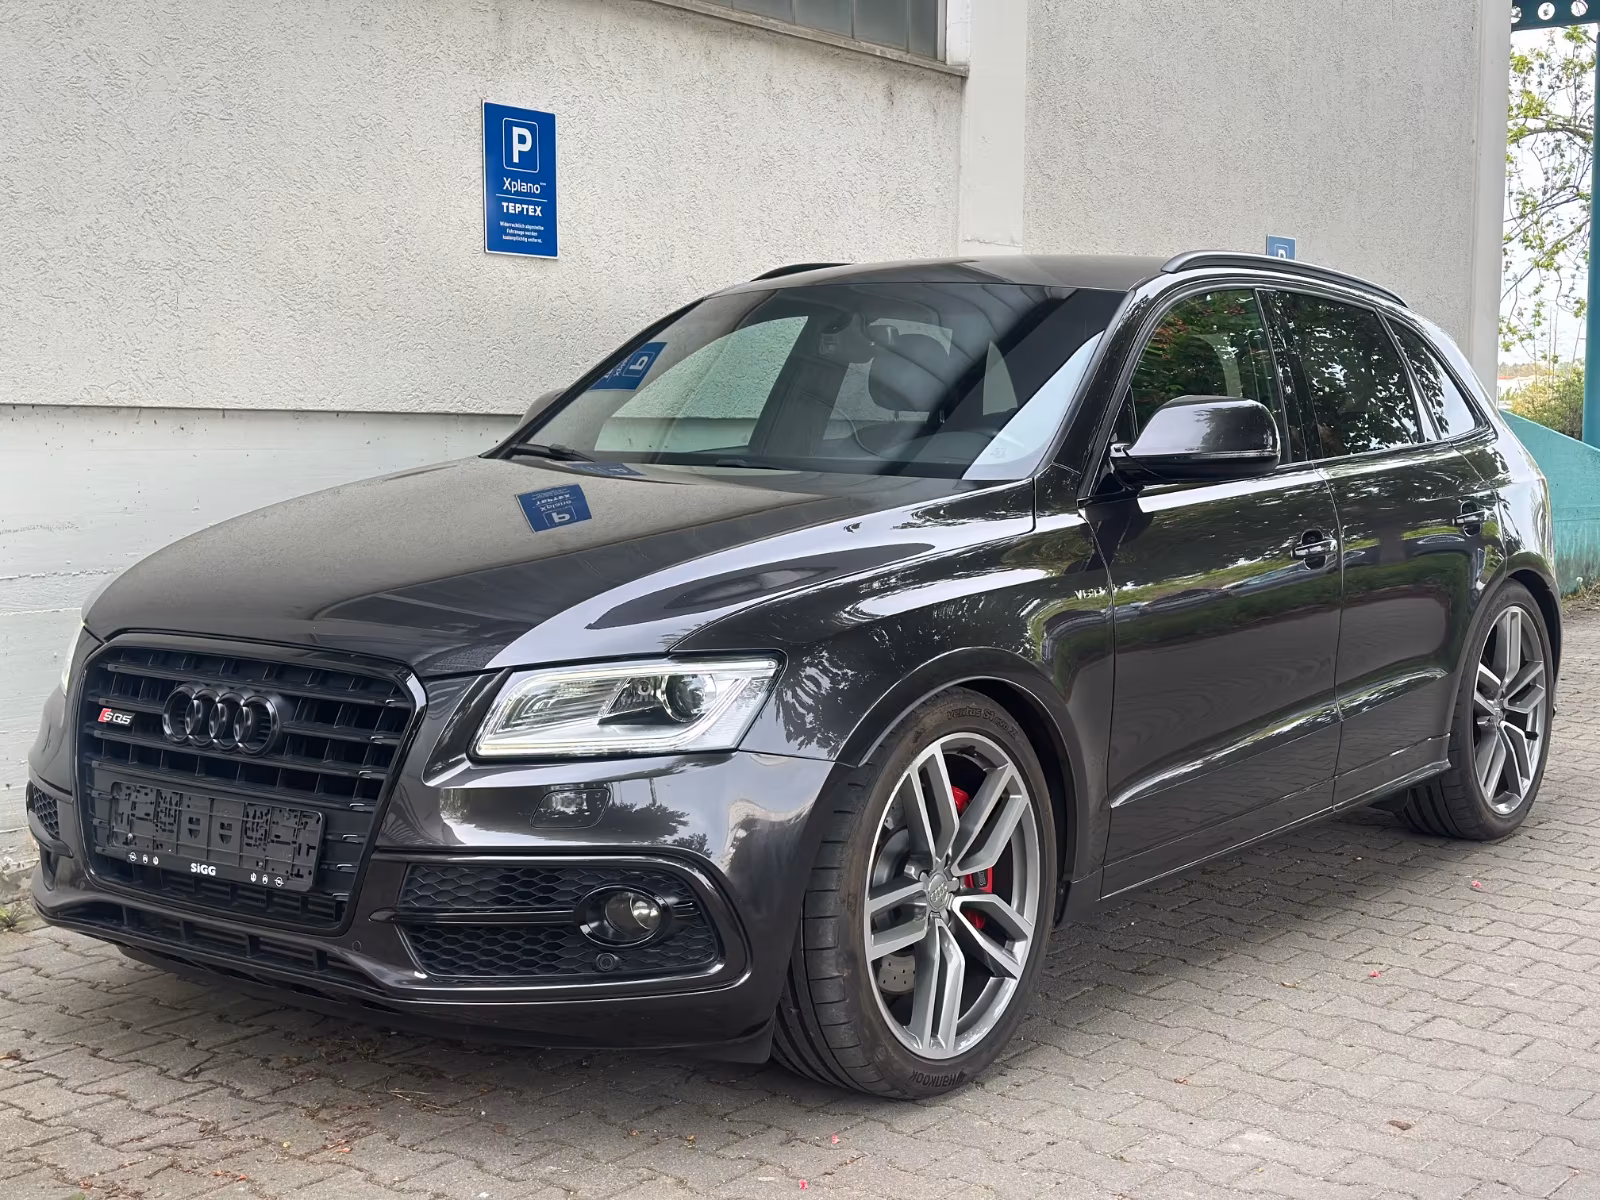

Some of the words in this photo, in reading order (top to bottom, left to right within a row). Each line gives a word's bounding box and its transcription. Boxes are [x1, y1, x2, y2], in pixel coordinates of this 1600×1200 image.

[512, 126, 532, 163] P
[503, 177, 541, 194] Xplano
[502, 202, 542, 217] TEPTEX
[103, 711, 132, 725] SQ5
